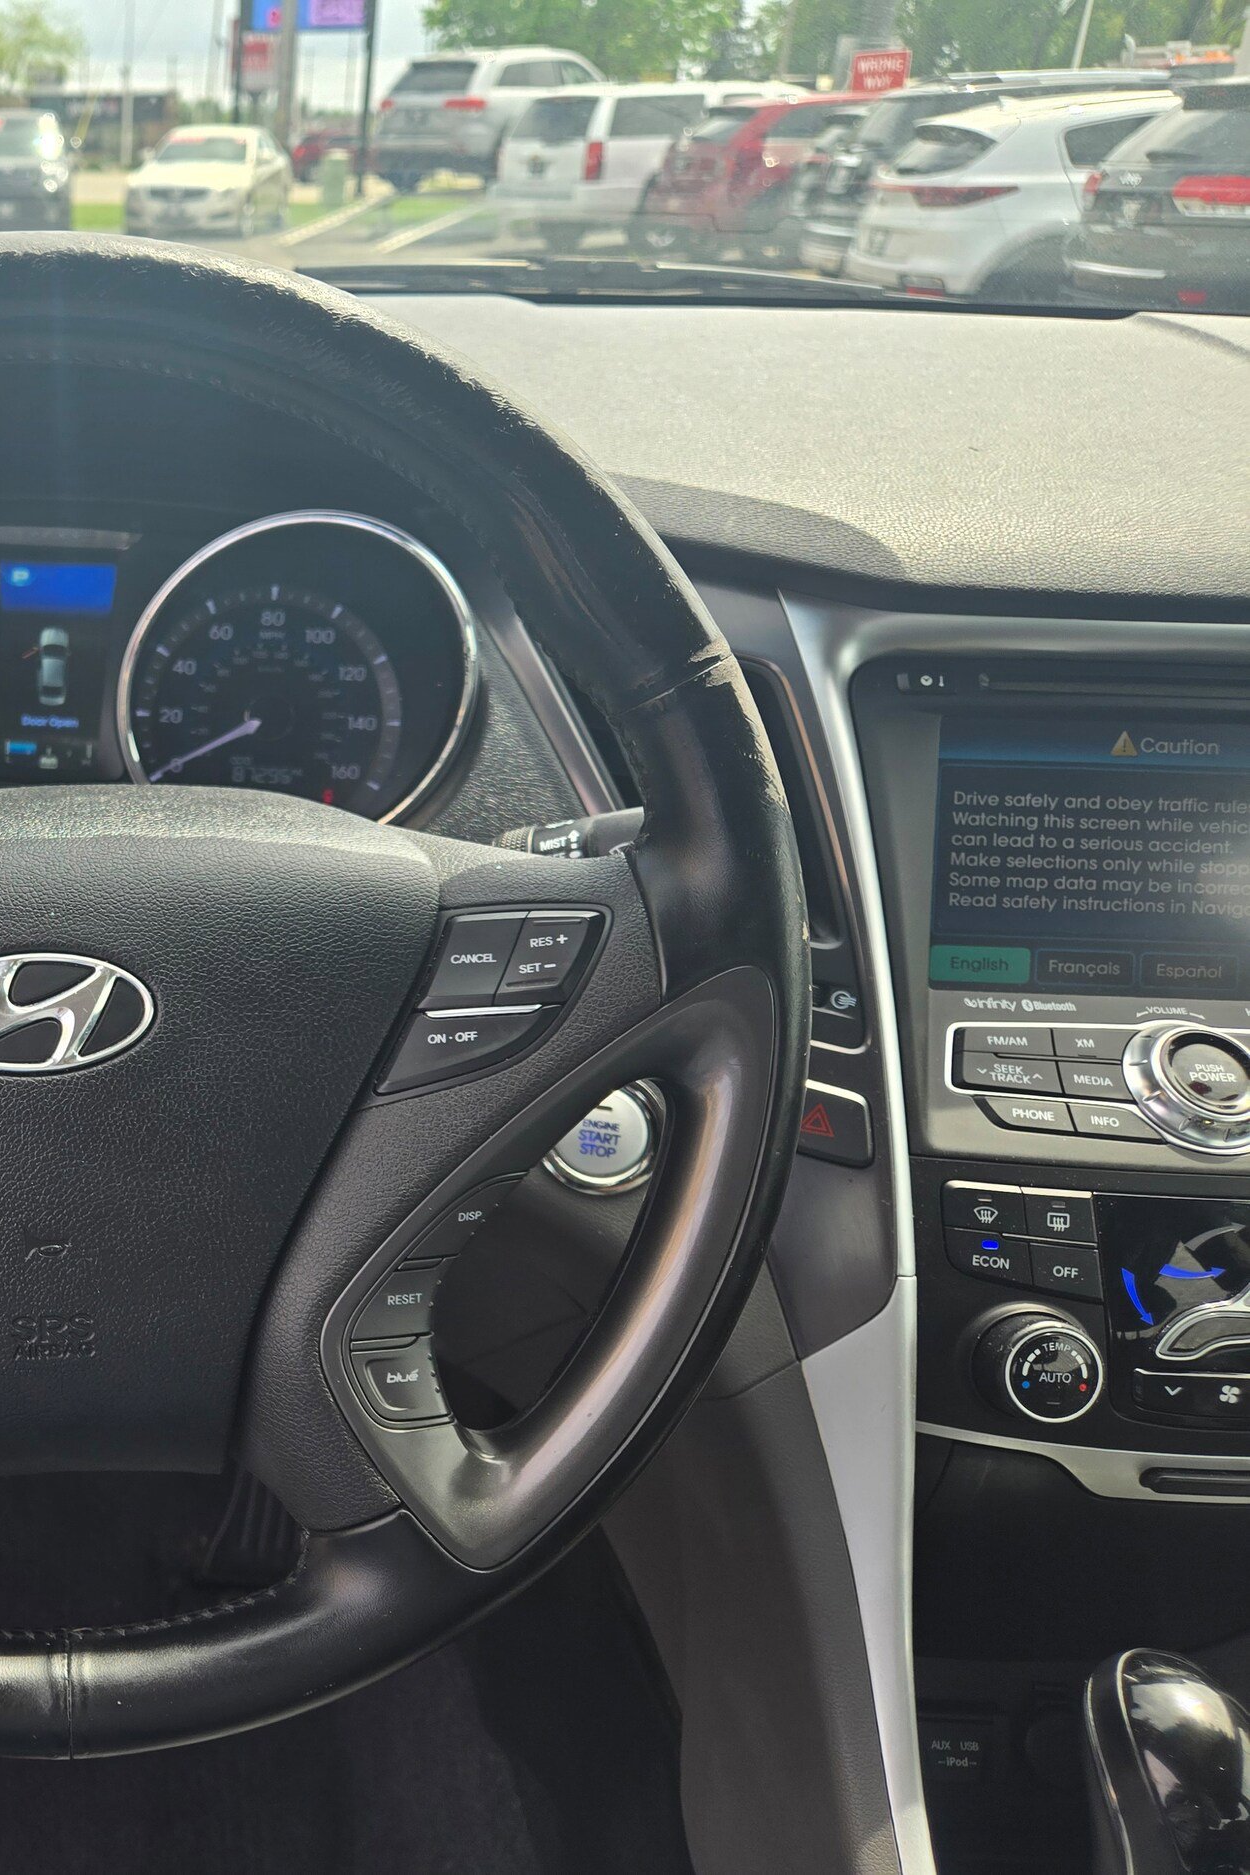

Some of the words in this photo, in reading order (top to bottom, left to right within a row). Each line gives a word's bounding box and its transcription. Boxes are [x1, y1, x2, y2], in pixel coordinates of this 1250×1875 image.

[857, 55, 904, 73] WRONG
[862, 75, 894, 90] WAY
[261, 611, 286, 627] 80
[209, 625, 234, 640] 60
[305, 629, 335, 644] 100
[172, 660, 197, 675] 40
[338, 666, 367, 681] 120
[21, 714, 48, 727] Door
[49, 715, 79, 729] Open
[159, 708, 183, 724] 20
[347, 716, 378, 731] 140
[1140, 737, 1220, 756] Caution
[331, 765, 361, 780] 160
[953, 791, 999, 807] Drive
[1004, 792, 1059, 811] safely
[1064, 794, 1101, 810] and
[1106, 795, 1153, 814] obey
[1157, 796, 1209, 814] traffic
[953, 811, 1039, 830] Watching
[1043, 812, 1075, 829] this
[1079, 816, 1141, 832] screen
[1146, 815, 1193, 832] while
[1198, 817, 1250, 834] vehic
[539, 837, 568, 851] MIST
[951, 833, 988, 848] can
[992, 831, 1034, 848] lead
[1039, 833, 1058, 849] to
[1062, 837, 1075, 850] a
[1080, 835, 1144, 852] serious
[1148, 836, 1233, 854] accident.
[951, 852, 1001, 868] Make
[1006, 853, 1098, 871] selections
[1103, 856, 1142, 875] only
[1147, 857, 1196, 874] while
[949, 872, 1001, 888] Some
[1006, 876, 1049, 894] map
[1053, 874, 1098, 891] data
[1103, 879, 1142, 896] may
[1148, 877, 1172, 894] be
[950, 892, 996, 909] Read
[1002, 894, 1057, 912] safety
[1063, 896, 1165, 914] instructions
[1170, 897, 1186, 914] in
[530, 936, 553, 948] RES
[450, 953, 497, 964] CANCEL
[950, 956, 1009, 974] English
[518, 962, 541, 974] SET
[1049, 959, 1121, 977] Français
[1156, 962, 1222, 981] Español
[1033, 1000, 1077, 1012] Bluetooth
[1146, 1006, 1188, 1016] VOLUME
[427, 1033, 446, 1044] ON
[455, 1031, 478, 1043] OFF
[986, 1036, 1028, 1047] FM/AM
[1075, 1038, 1095, 1048] XM
[993, 1063, 1024, 1075] SEEK
[1195, 1063, 1225, 1073] PUSH
[990, 1072, 1032, 1085] TRACK
[1074, 1074, 1113, 1087] MEDIA
[1189, 1070, 1236, 1083] POWER
[1012, 1107, 1055, 1122] PHONE
[1091, 1115, 1120, 1128] INFO
[582, 1119, 621, 1132] ENGINE
[578, 1129, 621, 1146] START
[579, 1143, 616, 1158] STOP
[458, 1211, 483, 1222] DISP
[972, 1255, 1010, 1270] ECON
[1053, 1266, 1079, 1279] OFF
[387, 1293, 423, 1306] RESET
[11, 1313, 96, 1344] SRS
[1042, 1341, 1072, 1353] TEMP
[1039, 1372, 1072, 1384] AUTO
[931, 1739, 951, 1751] AUX
[959, 1741, 980, 1752] USB
